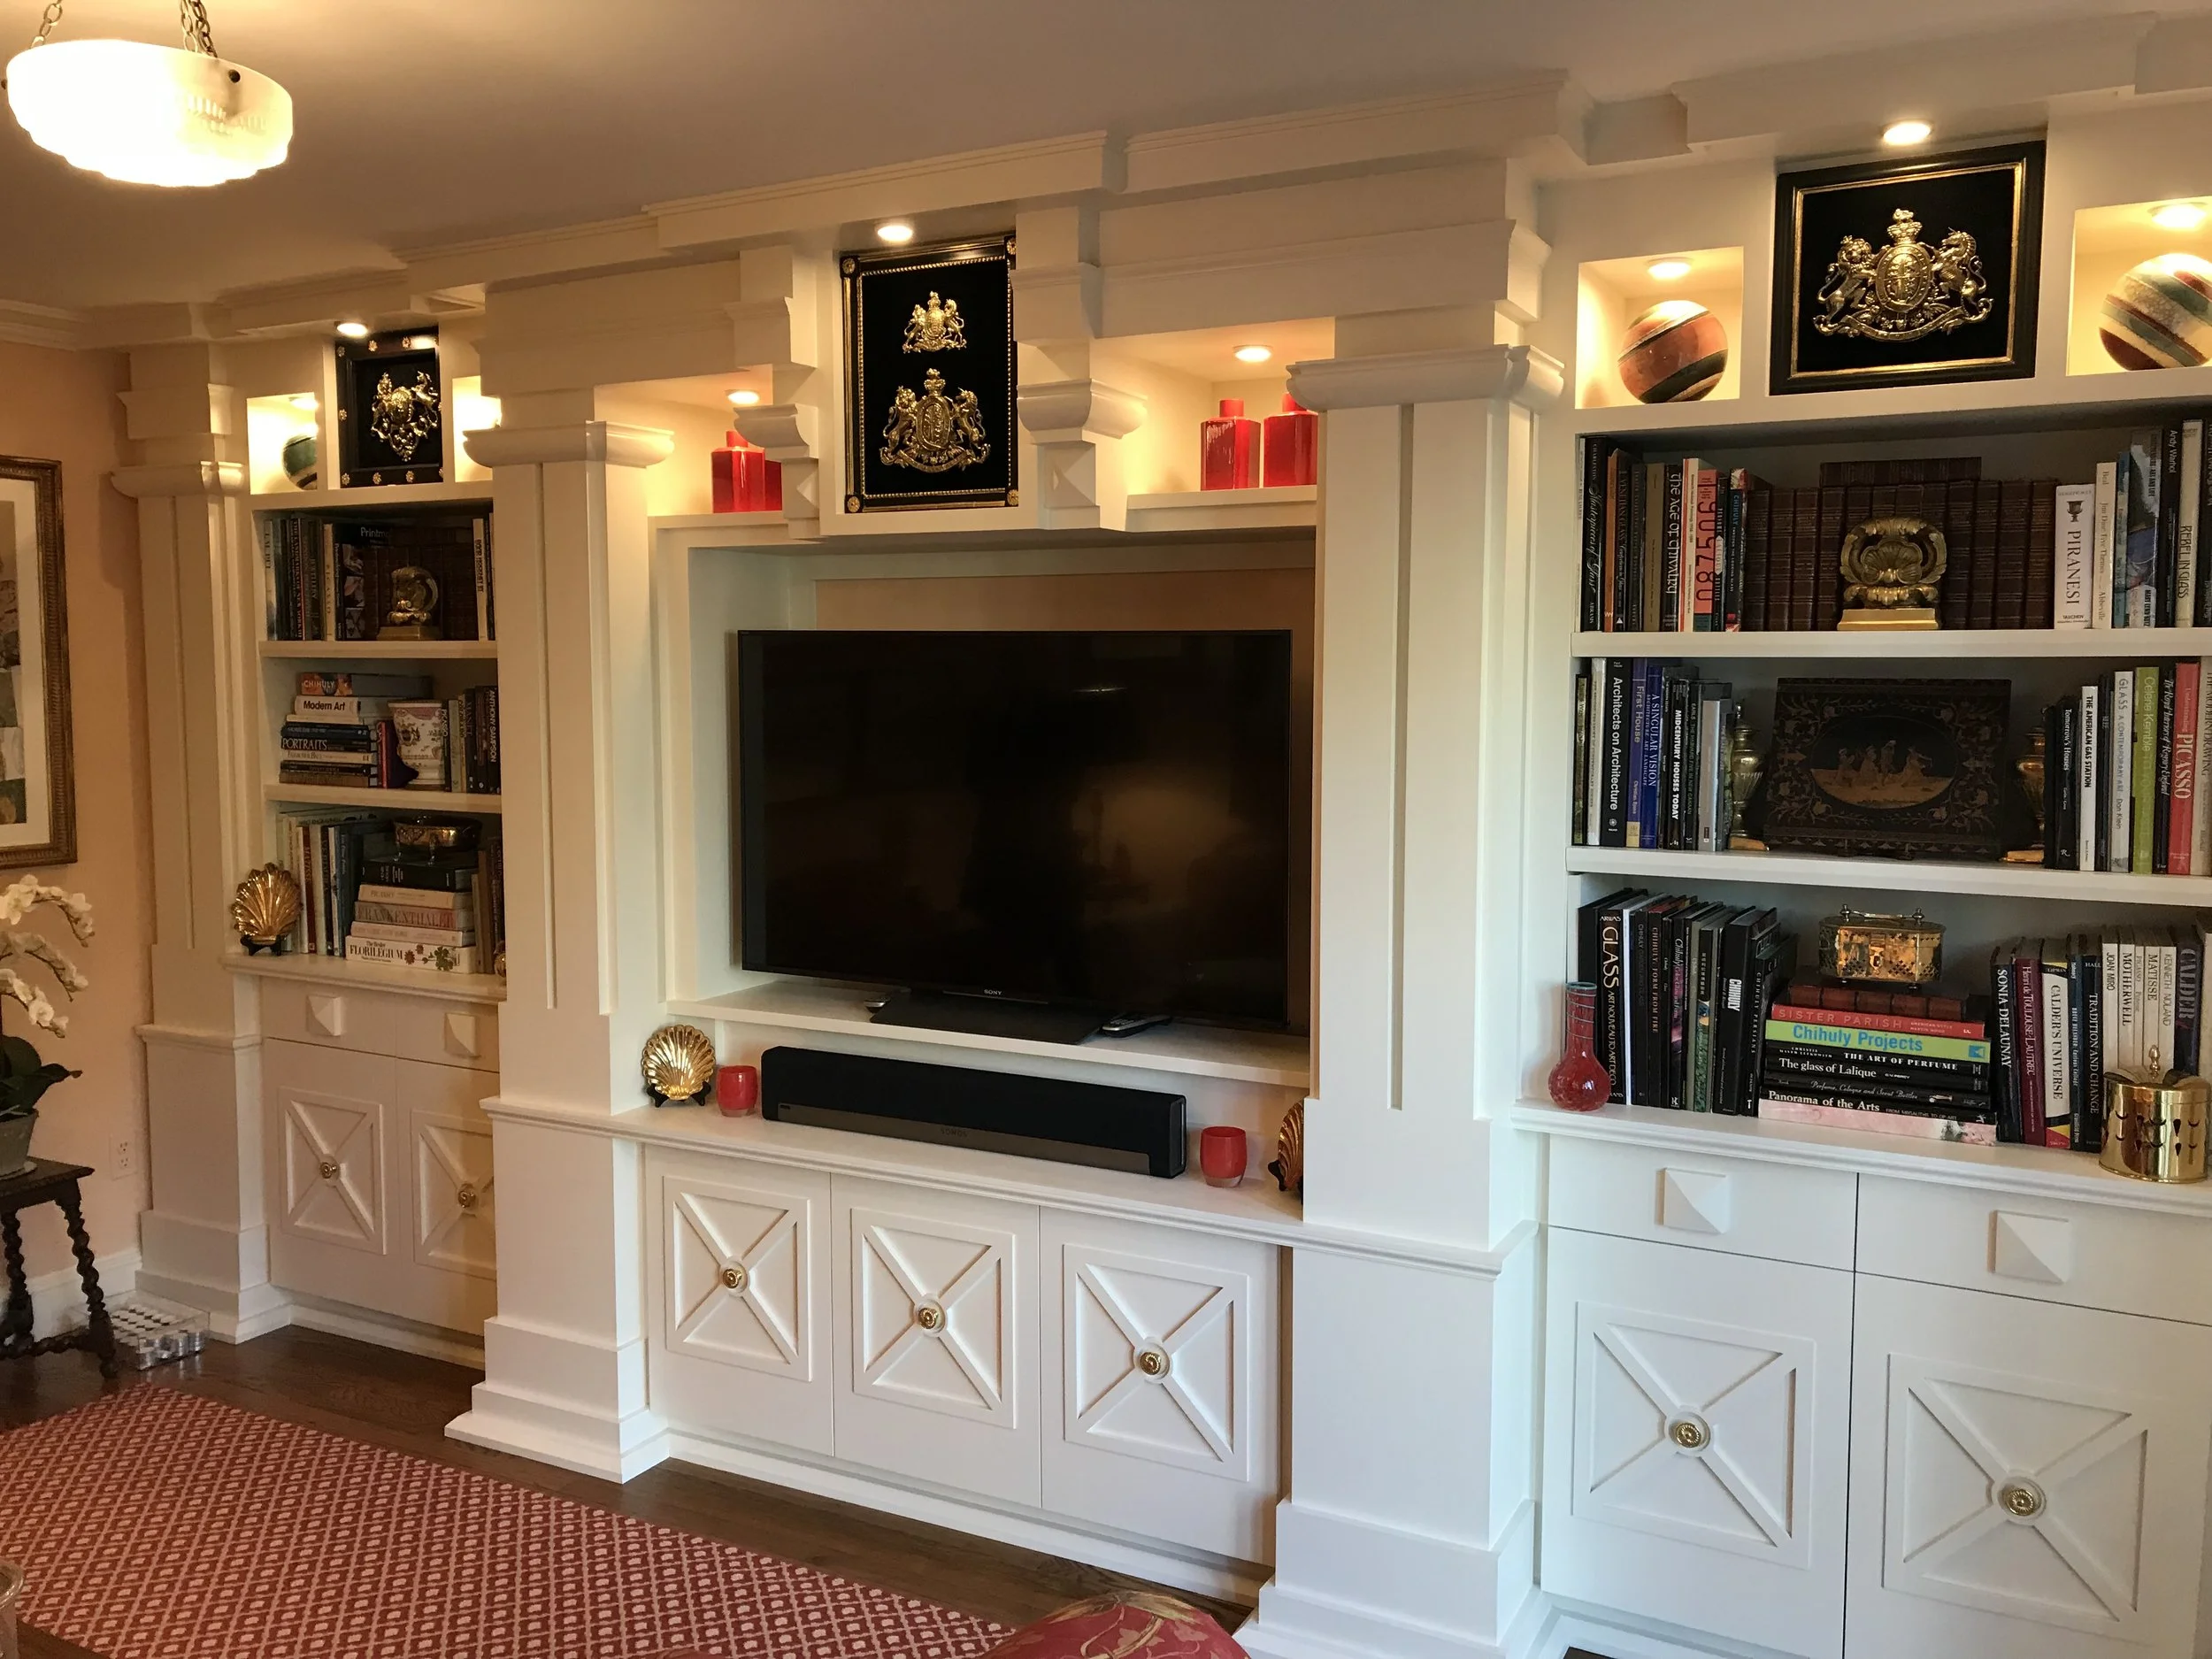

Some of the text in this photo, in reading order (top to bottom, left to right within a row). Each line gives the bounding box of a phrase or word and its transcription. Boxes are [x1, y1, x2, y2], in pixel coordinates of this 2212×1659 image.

[2168, 430, 2177, 473] Andy Warhol
[1586, 487, 1602, 594] Masterpieces of Glass
[1618, 514, 1627, 541] GLASS
[2066, 530, 2082, 604] PIRANESI
[2099, 549, 2108, 574] Themes
[2177, 525, 2193, 598] REBEL IN GLASS
[303, 680, 335, 688] CHIHULY
[2118, 678, 2129, 710] GLASS
[303, 700, 346, 711] Modern Art
[1612, 677, 1623, 730] Architects
[1634, 686, 1644, 742] First House
[282, 737, 327, 750] PORTRAITS
[488, 726, 497, 763] SAMPSON
[1612, 732, 1621, 746] on
[1649, 703, 1660, 751] SINGULAR
[2062, 709, 2072, 771] Tomorrow's Houses
[2085, 710, 2093, 745] AMERICAN
[2141, 714, 2154, 752] Kemble
[1648, 754, 1657, 787] VISION
[2173, 733, 2194, 799] PICASSO
[2201, 733, 2212, 776] DRAWING
[1610, 747, 1622, 810] Architecture
[357, 904, 455, 929] FRANKENTHALER
[349, 944, 403, 960] FLORILEGIUM
[1601, 926, 1619, 988] GLASS
[1671, 938, 1684, 966] Chihuly
[2106, 952, 2116, 971] JOAN
[2022, 966, 2032, 986] Henri
[2122, 952, 2132, 1026] MOTHERWELL
[2147, 954, 2158, 1001] MATISSE
[2162, 954, 2172, 1026] KENNETH NOLAND
[2177, 948, 2197, 1020] CALDER
[1727, 979, 1742, 1011] CHIHULY
[1607, 1004, 1616, 1041] NOUVEAU
[1778, 1009, 1902, 1029] SISTER PARISH
[1996, 969, 2012, 1068] SONIA DELAUNAY
[1608, 1041, 1617, 1050] TO
[1793, 1025, 1924, 1051] Chihuly Projects
[2050, 985, 2063, 1100] CALDER'S UNIVERSE
[2088, 993, 2100, 1114] TRADITION AND CHANGE
[1778, 1057, 1877, 1079] The glass of Lalique
[1907, 1058, 1958, 1071] PERFUME
[1768, 1089, 1880, 1111] Panorama of the Arts
[1839, 1083, 1862, 1094] Cologne
[940, 1128, 969, 1139] SONOS
